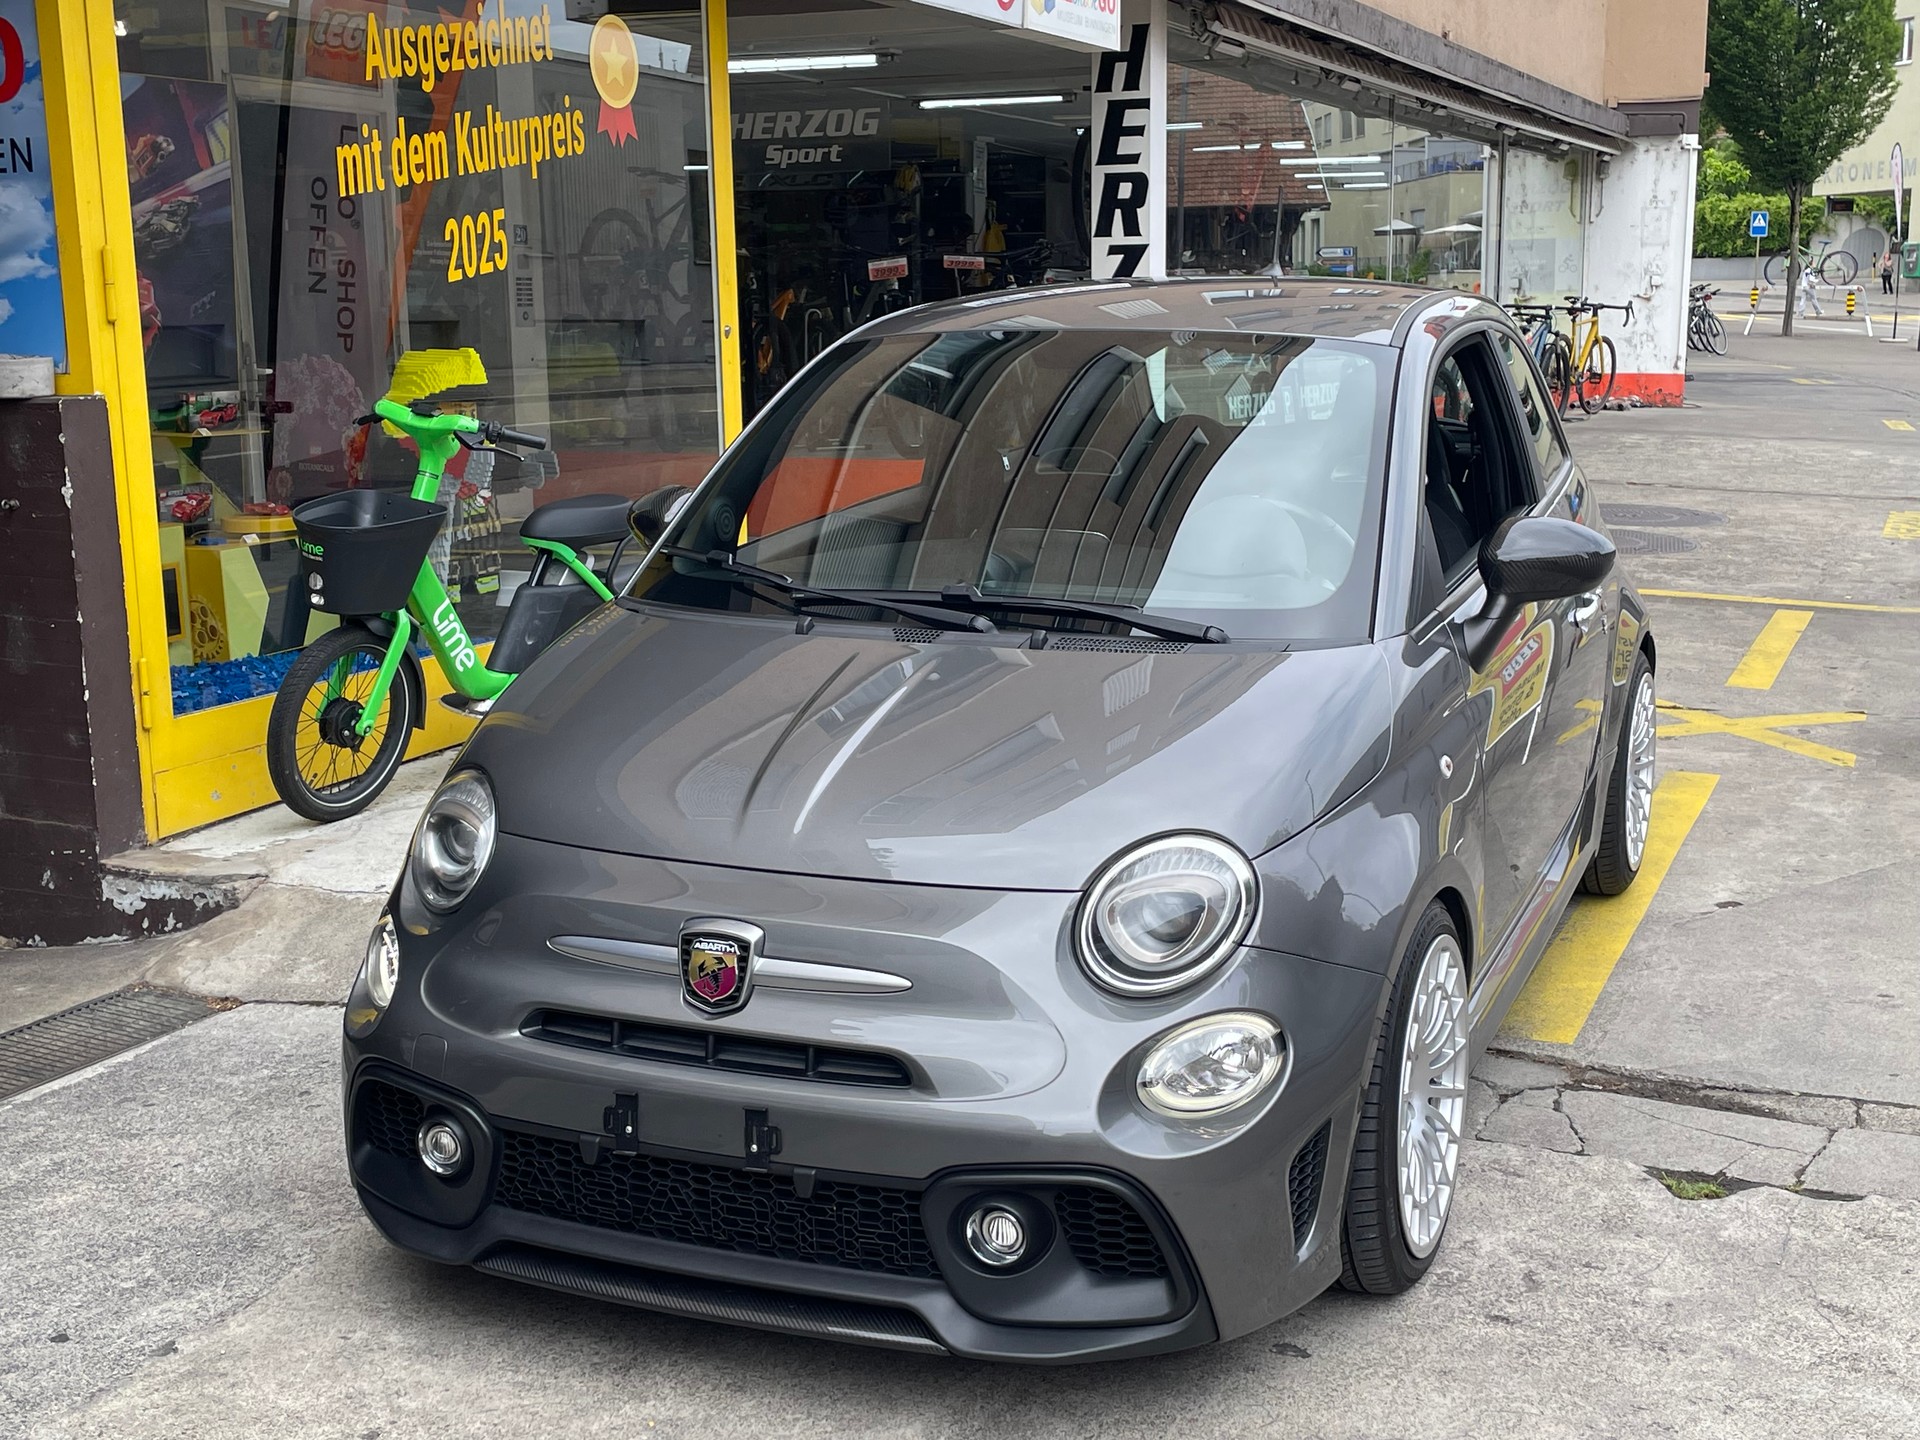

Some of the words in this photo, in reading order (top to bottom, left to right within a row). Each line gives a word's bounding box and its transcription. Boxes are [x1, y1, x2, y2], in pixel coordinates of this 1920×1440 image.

[313, 9, 372, 50] LEG
[365, 3, 554, 93] Ausgezeichnet
[336, 124, 385, 198] mit
[392, 117, 450, 188] dem
[454, 95, 586, 180] Kulturpreis
[732, 107, 881, 140] HERZOG
[764, 144, 843, 169] Sport
[1823, 158, 1917, 184] KRONEM
[308, 176, 328, 294] OFFEN
[445, 208, 509, 283] 2025
[336, 258, 357, 354] SHOP
[694, 941, 736, 954] ABARTH
